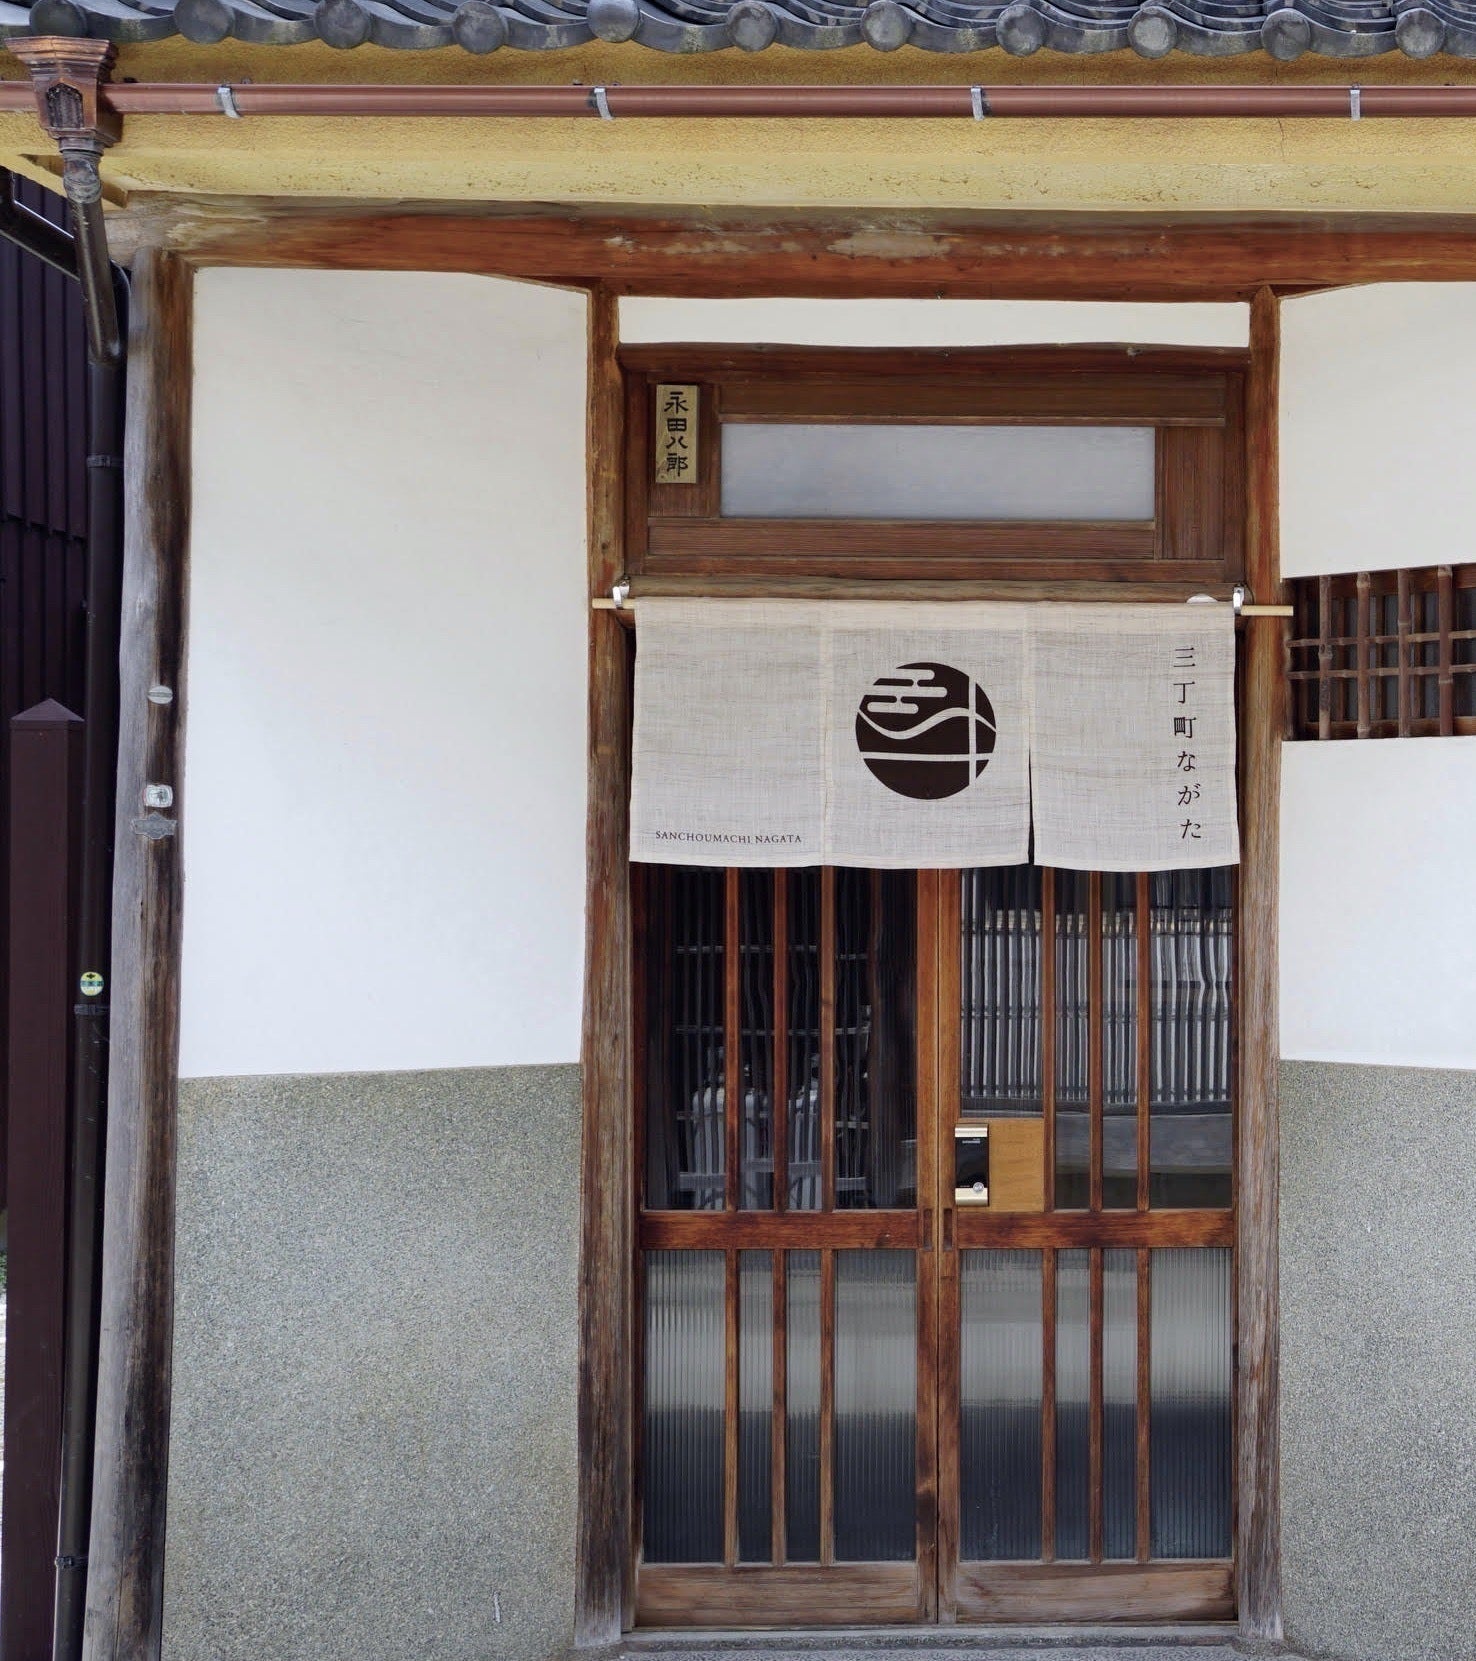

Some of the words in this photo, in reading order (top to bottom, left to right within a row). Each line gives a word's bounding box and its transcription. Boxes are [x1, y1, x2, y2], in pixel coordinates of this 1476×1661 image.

[663, 391, 689, 477] 永田八郎
[1173, 647, 1202, 840] 三丁町ながた
[655, 830, 751, 844] SANCHOUMACHI
[755, 834, 802, 844] NAGATA
